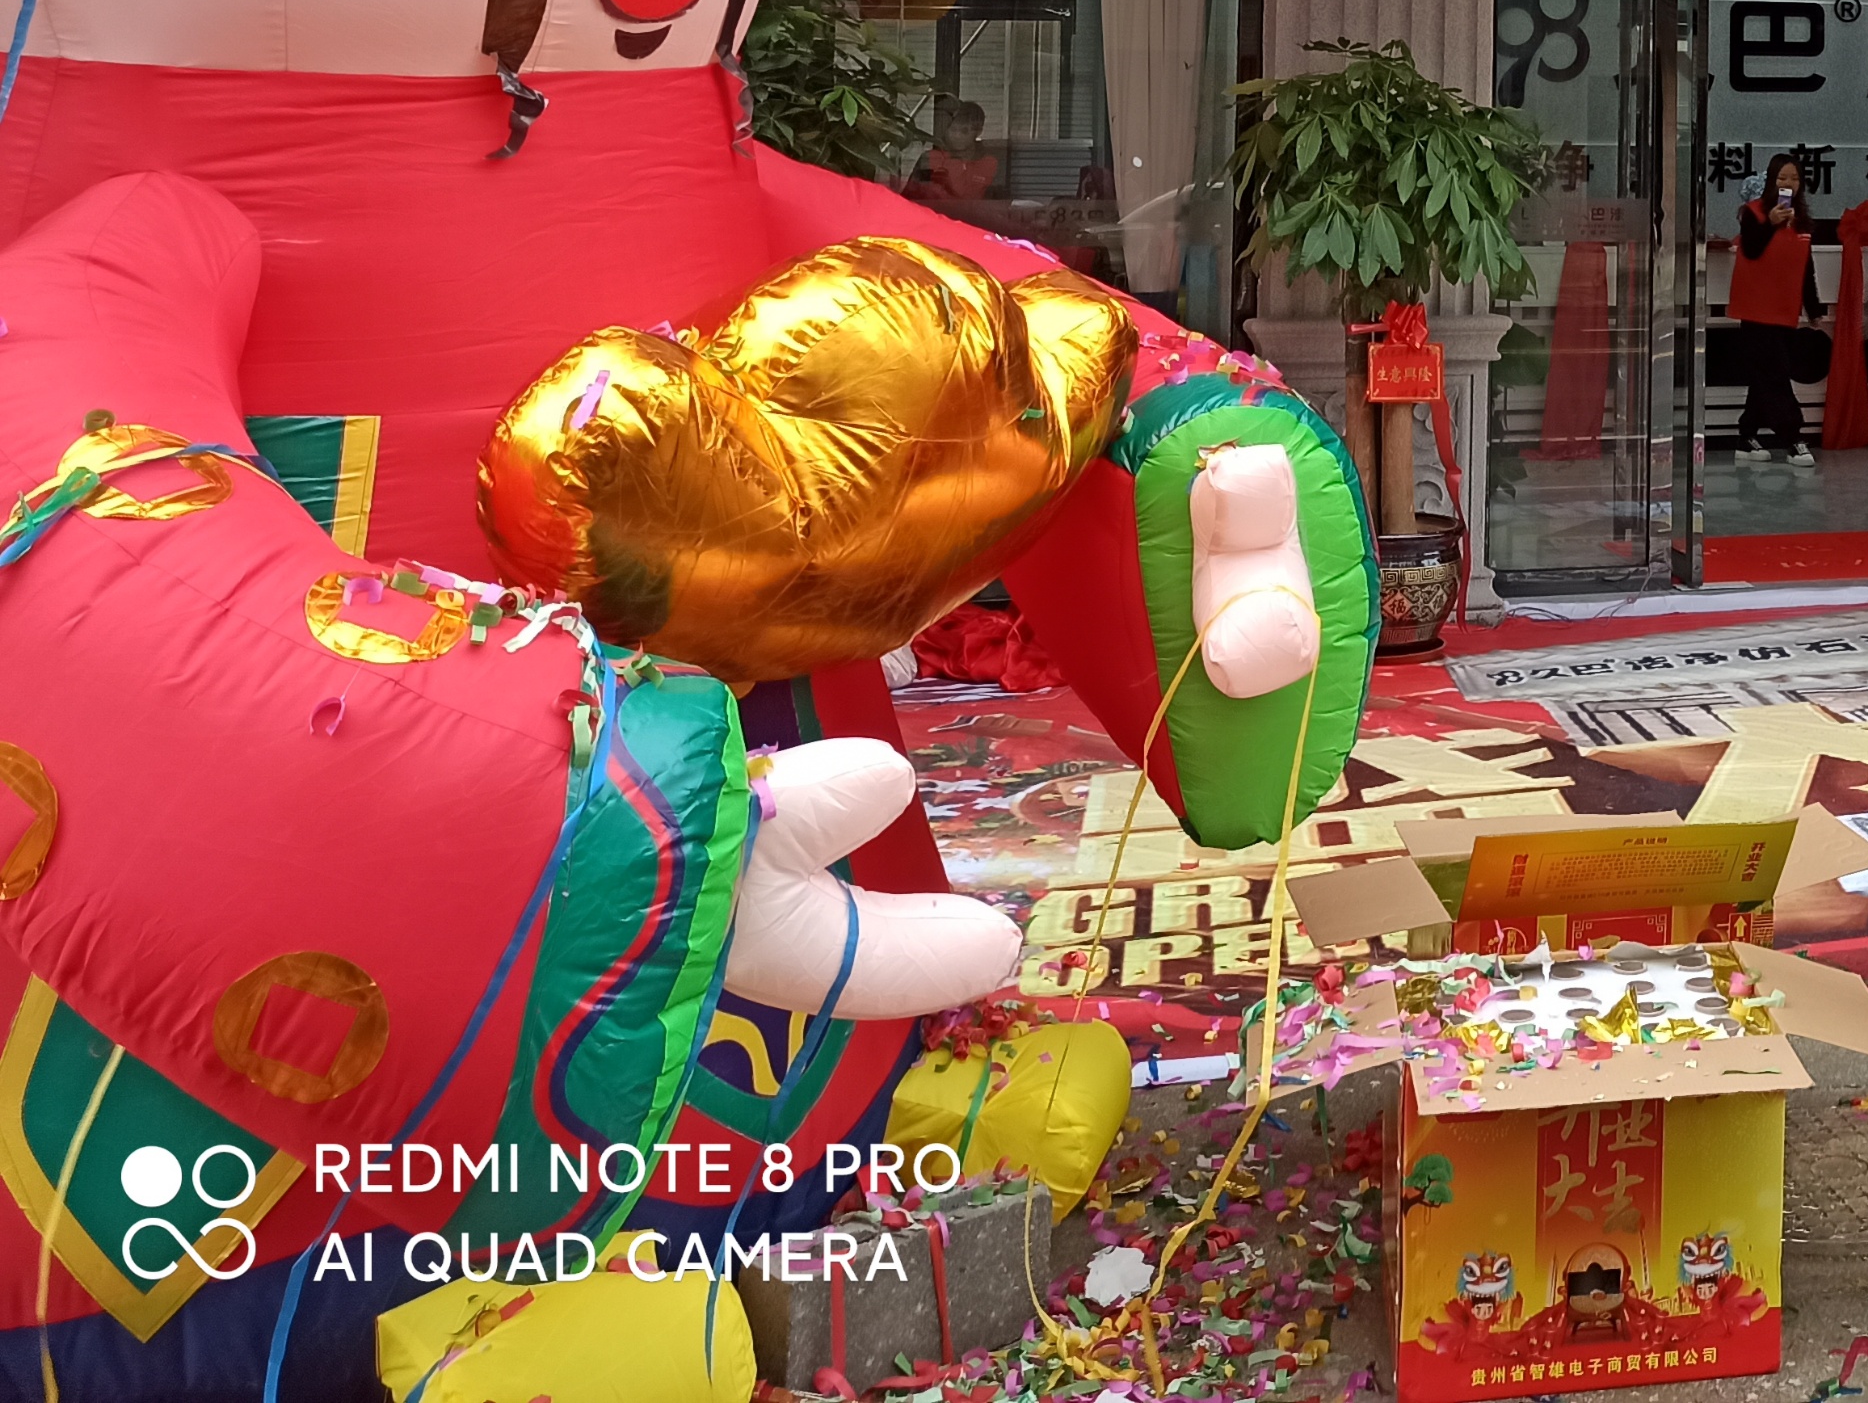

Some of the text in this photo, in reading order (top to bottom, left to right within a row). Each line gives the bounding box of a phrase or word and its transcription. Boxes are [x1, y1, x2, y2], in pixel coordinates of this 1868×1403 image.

[1470, 1346, 1719, 1387] 贵州省智雄电子商贸有限公司
